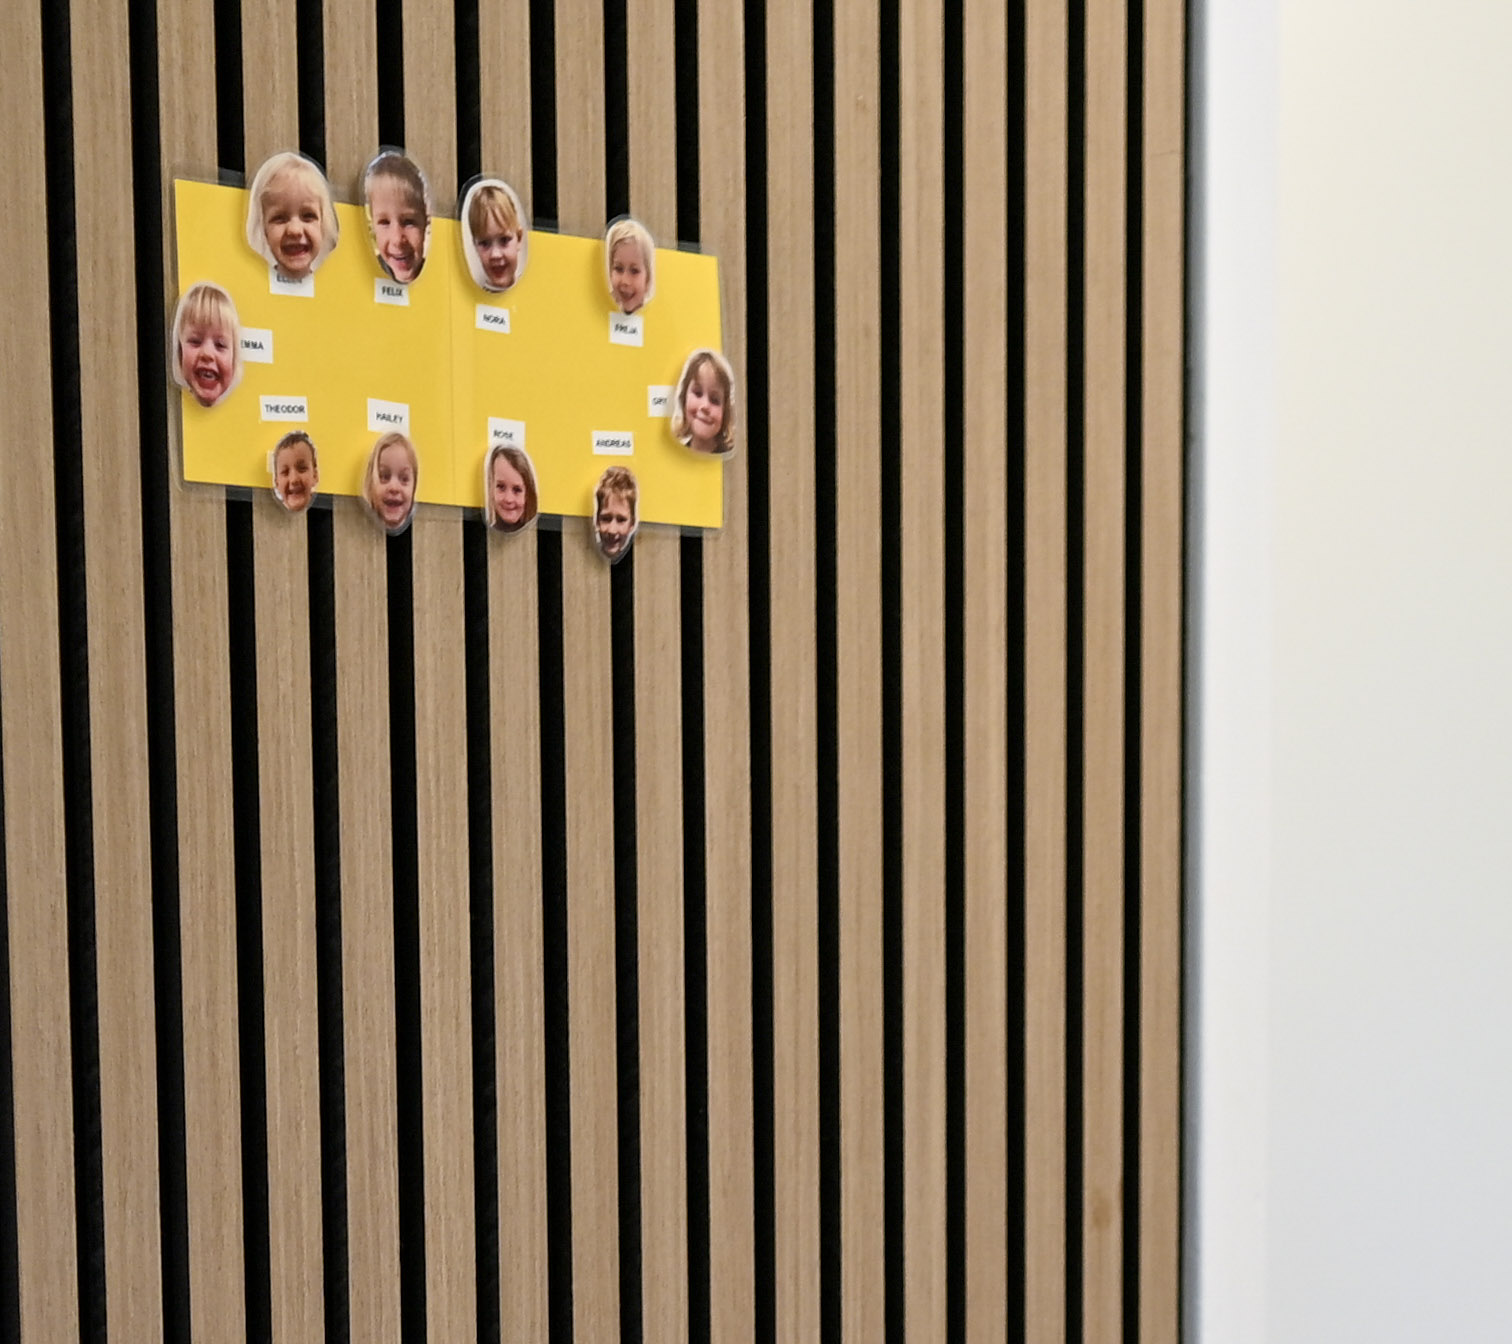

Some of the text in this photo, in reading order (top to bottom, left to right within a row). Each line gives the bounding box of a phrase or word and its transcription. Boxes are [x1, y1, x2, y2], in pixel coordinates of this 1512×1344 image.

[381, 285, 403, 297] FELIX
[240, 339, 264, 350] EMMA
[264, 404, 306, 414] THEODOR
